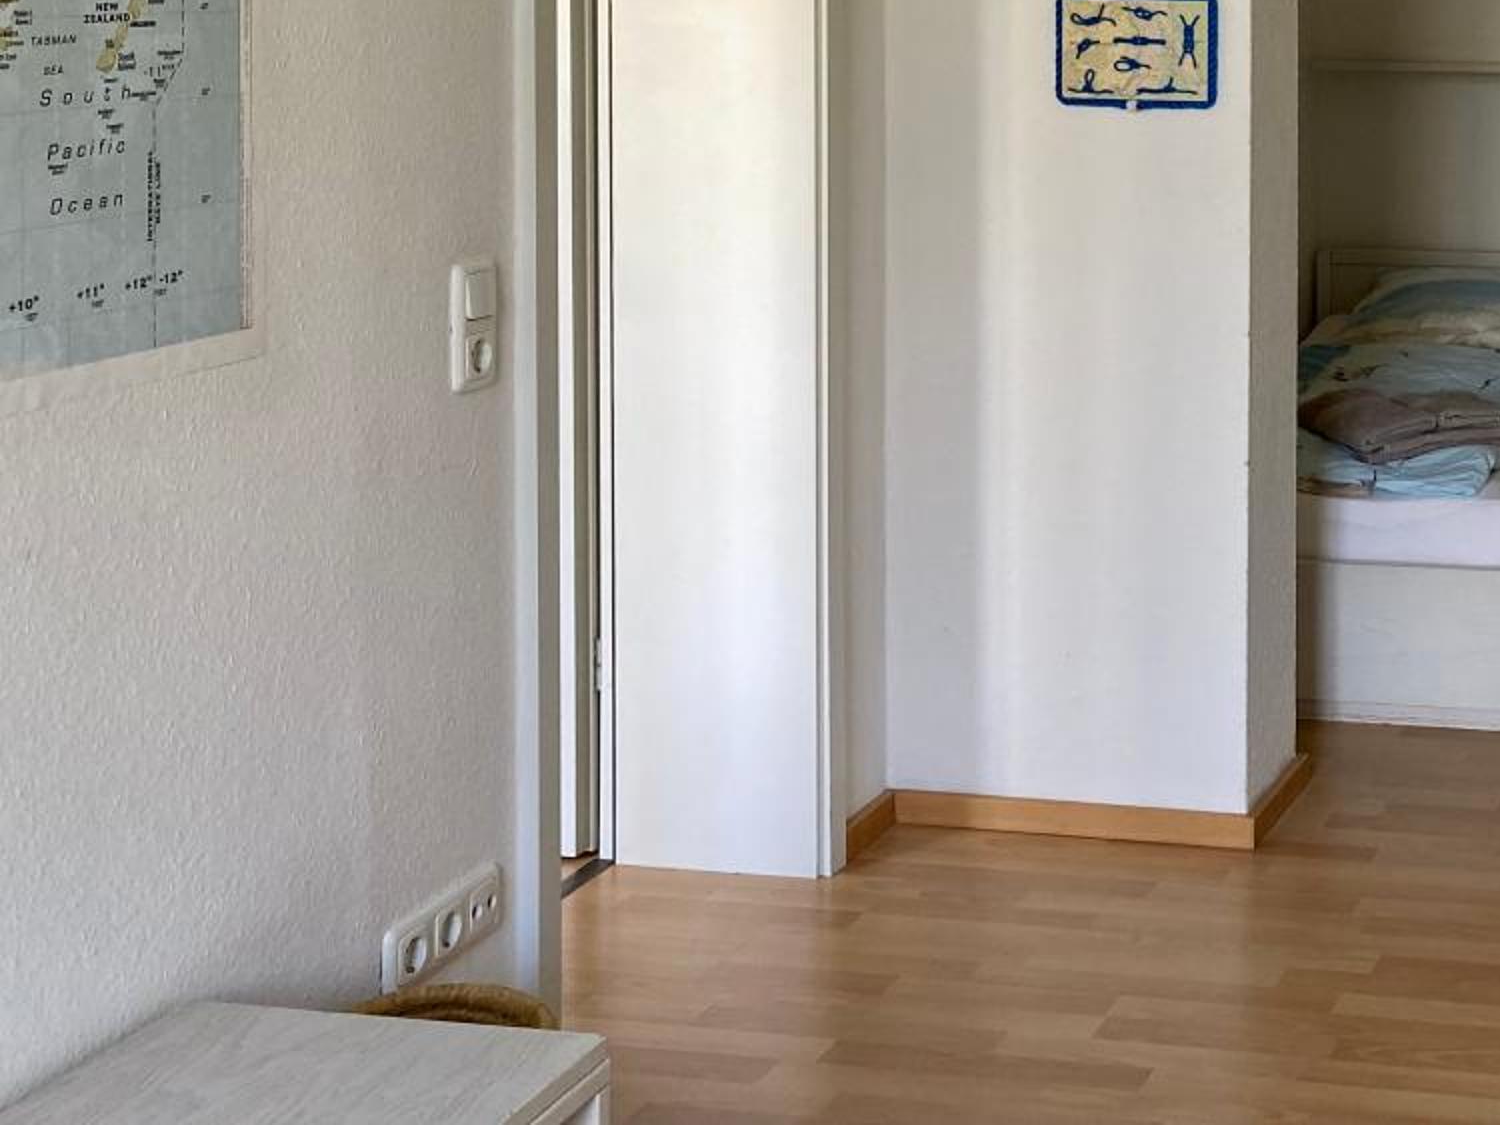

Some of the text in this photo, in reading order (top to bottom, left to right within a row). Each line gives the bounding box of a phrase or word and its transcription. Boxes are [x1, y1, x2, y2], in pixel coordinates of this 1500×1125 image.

[95, 3, 119, 12] NEW
[83, 12, 131, 24] ZEALAND
[30, 34, 77, 46] TASMAN
[39, 86, 132, 107] South
[47, 138, 126, 161] Pacific
[49, 192, 124, 216] Ocean
